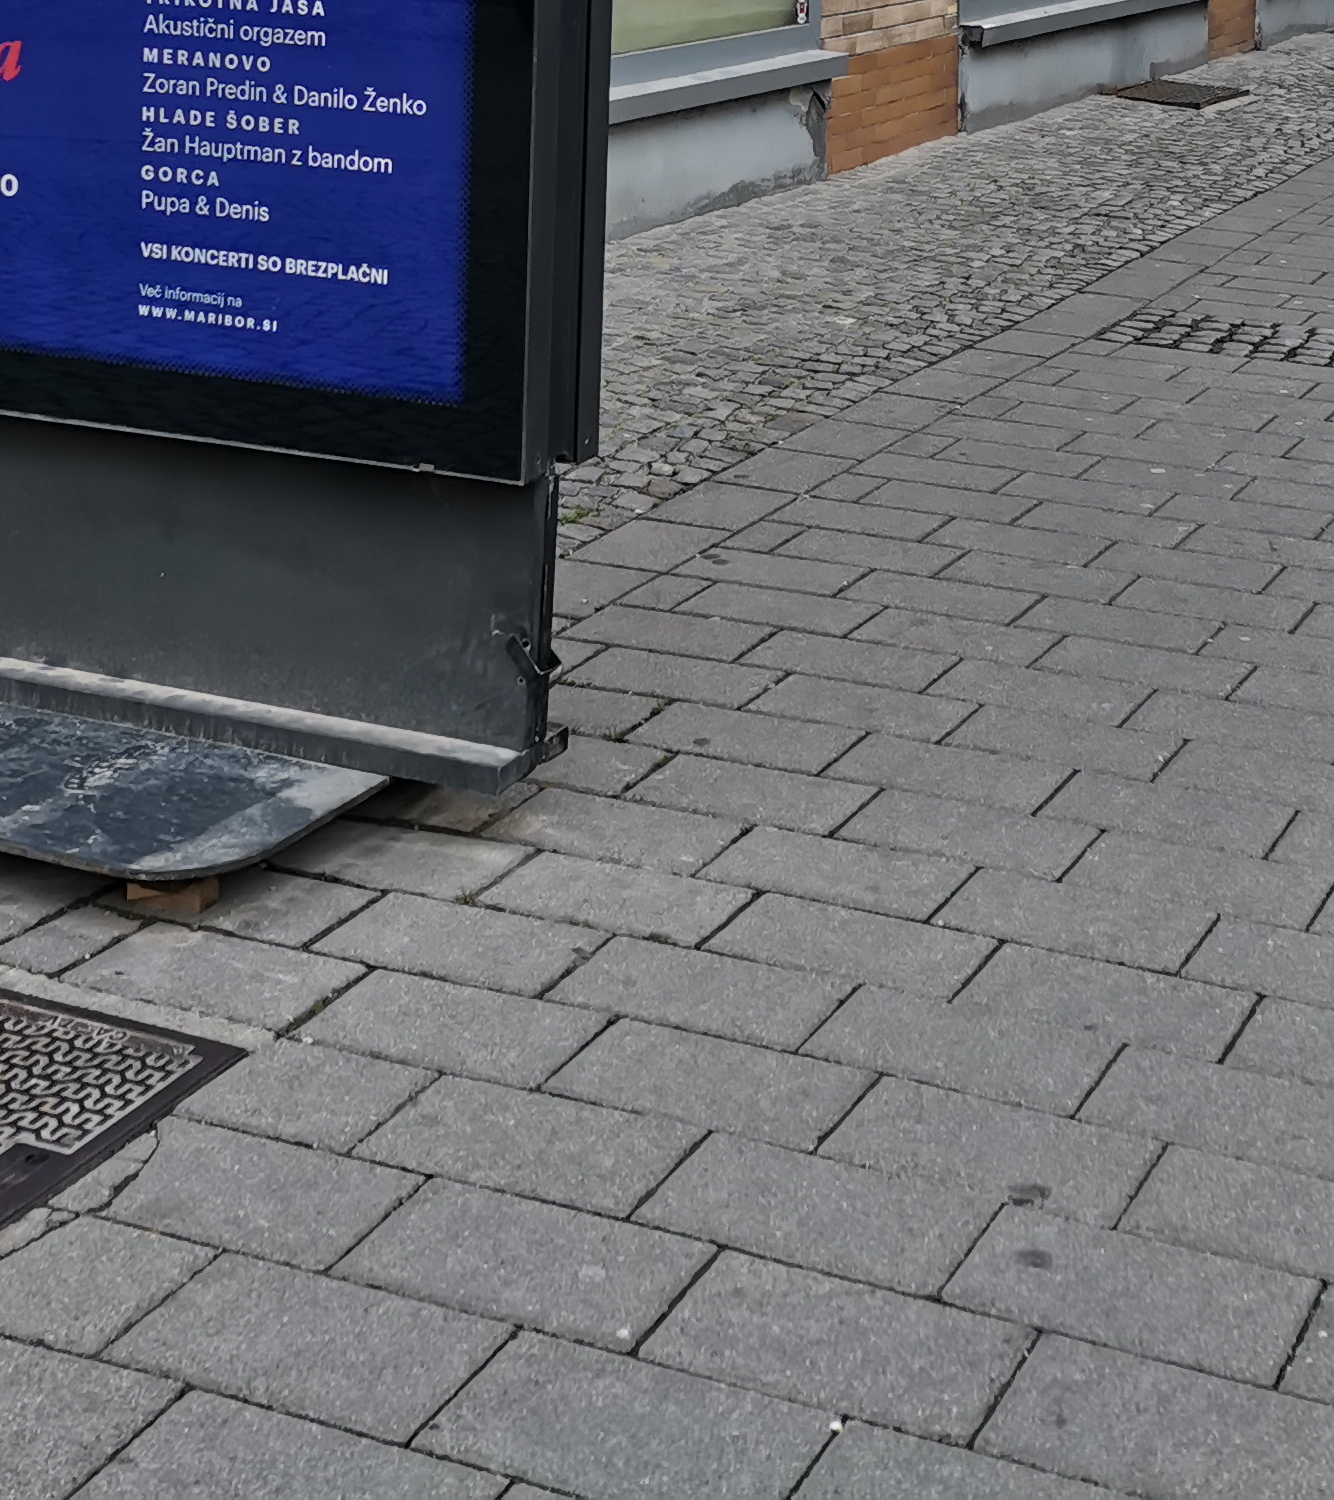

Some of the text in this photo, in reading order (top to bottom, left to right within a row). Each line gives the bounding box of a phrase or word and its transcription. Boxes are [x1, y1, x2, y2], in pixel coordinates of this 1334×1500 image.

[142, 13, 327, 47] Akustični orgazem
[142, 47, 272, 73] MERANOVO
[142, 72, 427, 116] Zoran Predin & Danilo Ženko
[141, 106, 301, 135] HLADE ŠOBER
[141, 127, 393, 175] Žan Hauptman z bandom
[140, 165, 220, 187] GORCA
[141, 190, 271, 223] Pupa & Denis
[140, 241, 389, 286] VSI KONCERTI SO BREZPLAČNI
[138, 282, 243, 309] Več informacij na
[138, 304, 278, 333] WWW.MARIBOR.SI
